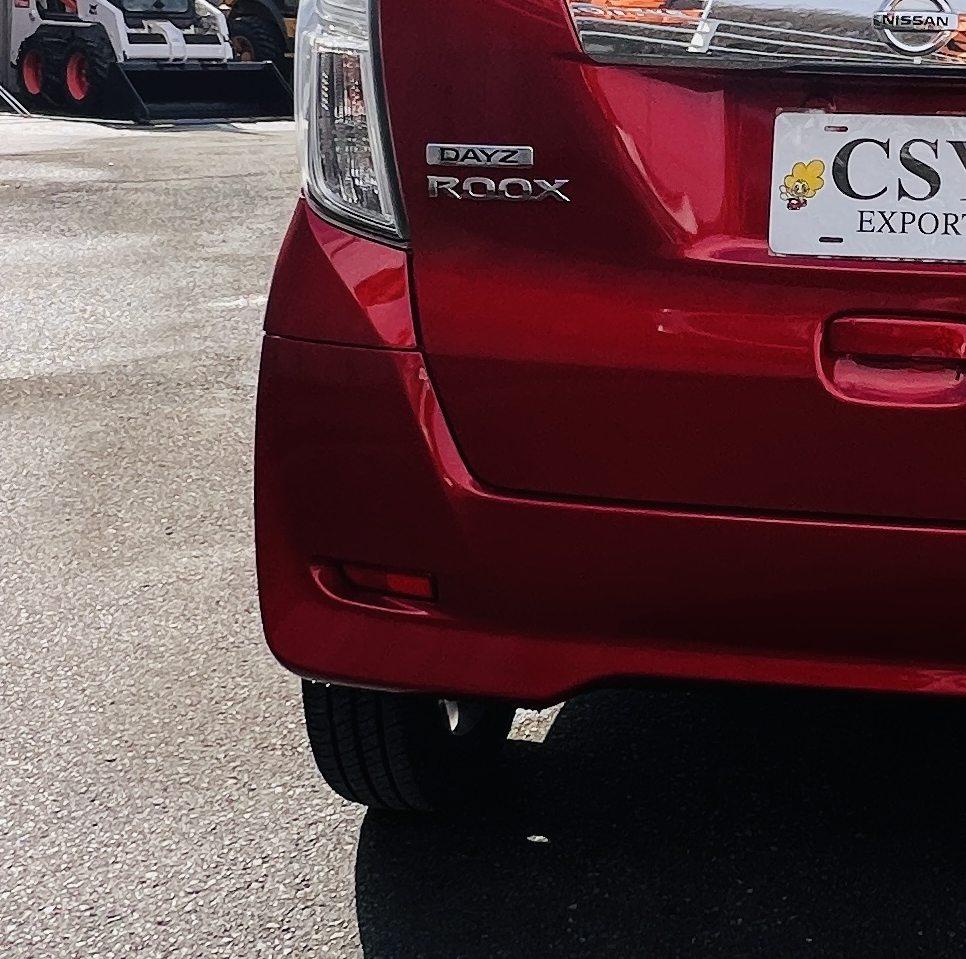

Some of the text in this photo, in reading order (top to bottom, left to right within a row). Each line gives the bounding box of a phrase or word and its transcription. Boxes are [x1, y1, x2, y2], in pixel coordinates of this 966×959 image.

[881, 14, 949, 26] NISSAN
[439, 147, 519, 164] DAYZ
[426, 175, 571, 202] ROOX
